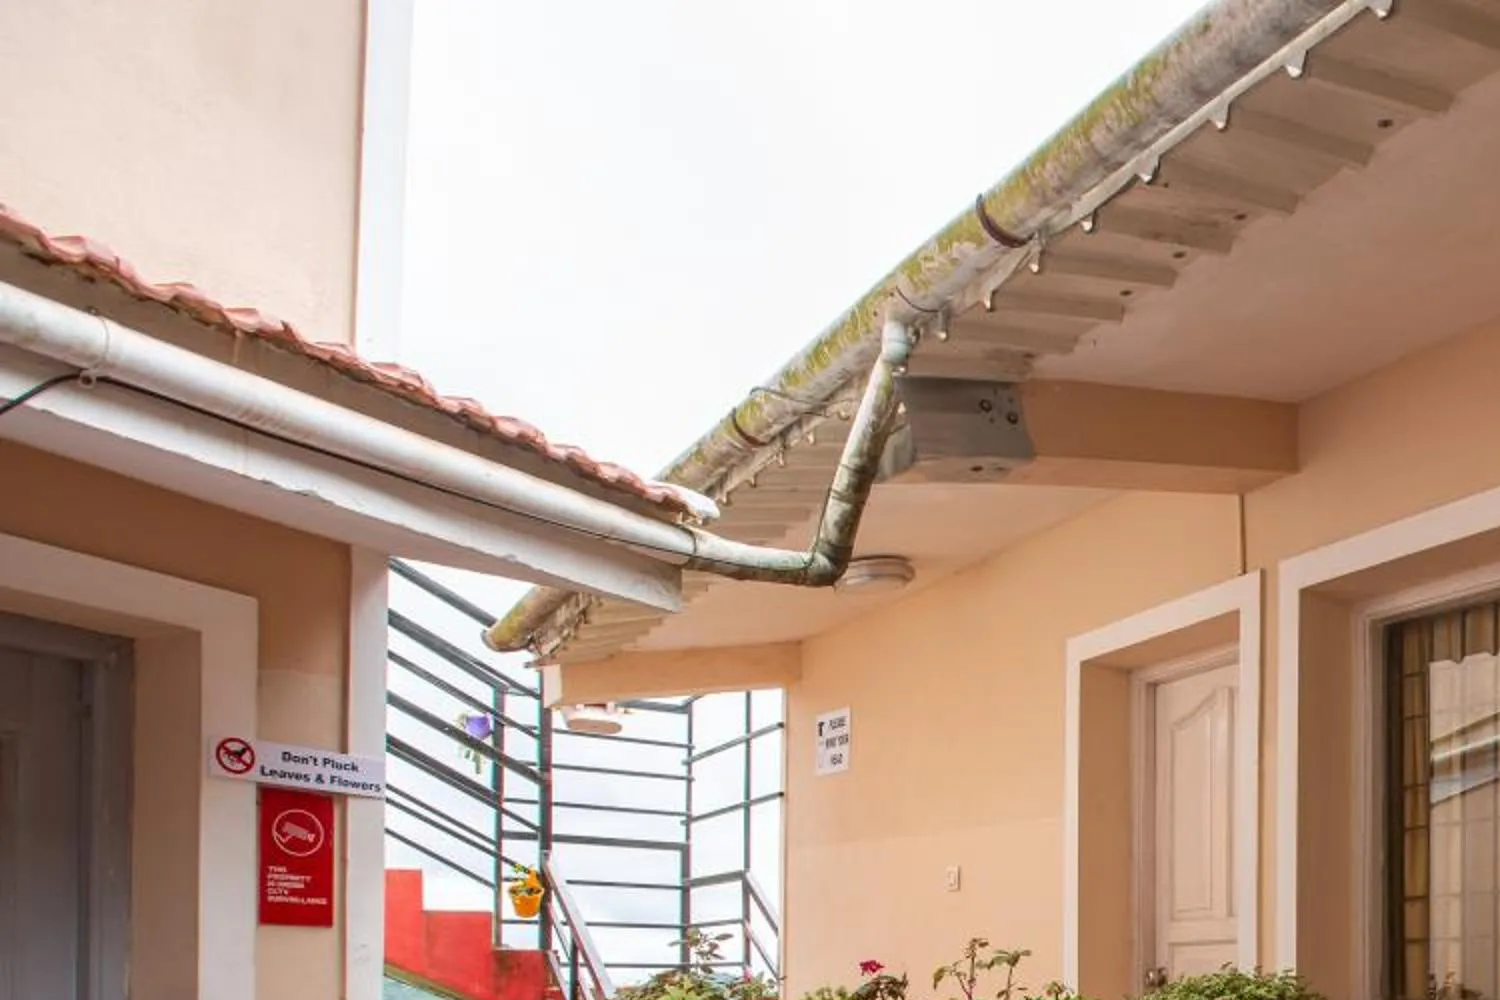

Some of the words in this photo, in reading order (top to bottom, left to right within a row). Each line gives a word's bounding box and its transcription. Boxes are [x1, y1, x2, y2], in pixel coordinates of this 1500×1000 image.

[281, 751, 318, 767] Don't
[323, 757, 359, 773] Pluck
[260, 764, 311, 783] Leaves
[314, 773, 325, 785] &
[330, 775, 381, 793] Flowers
